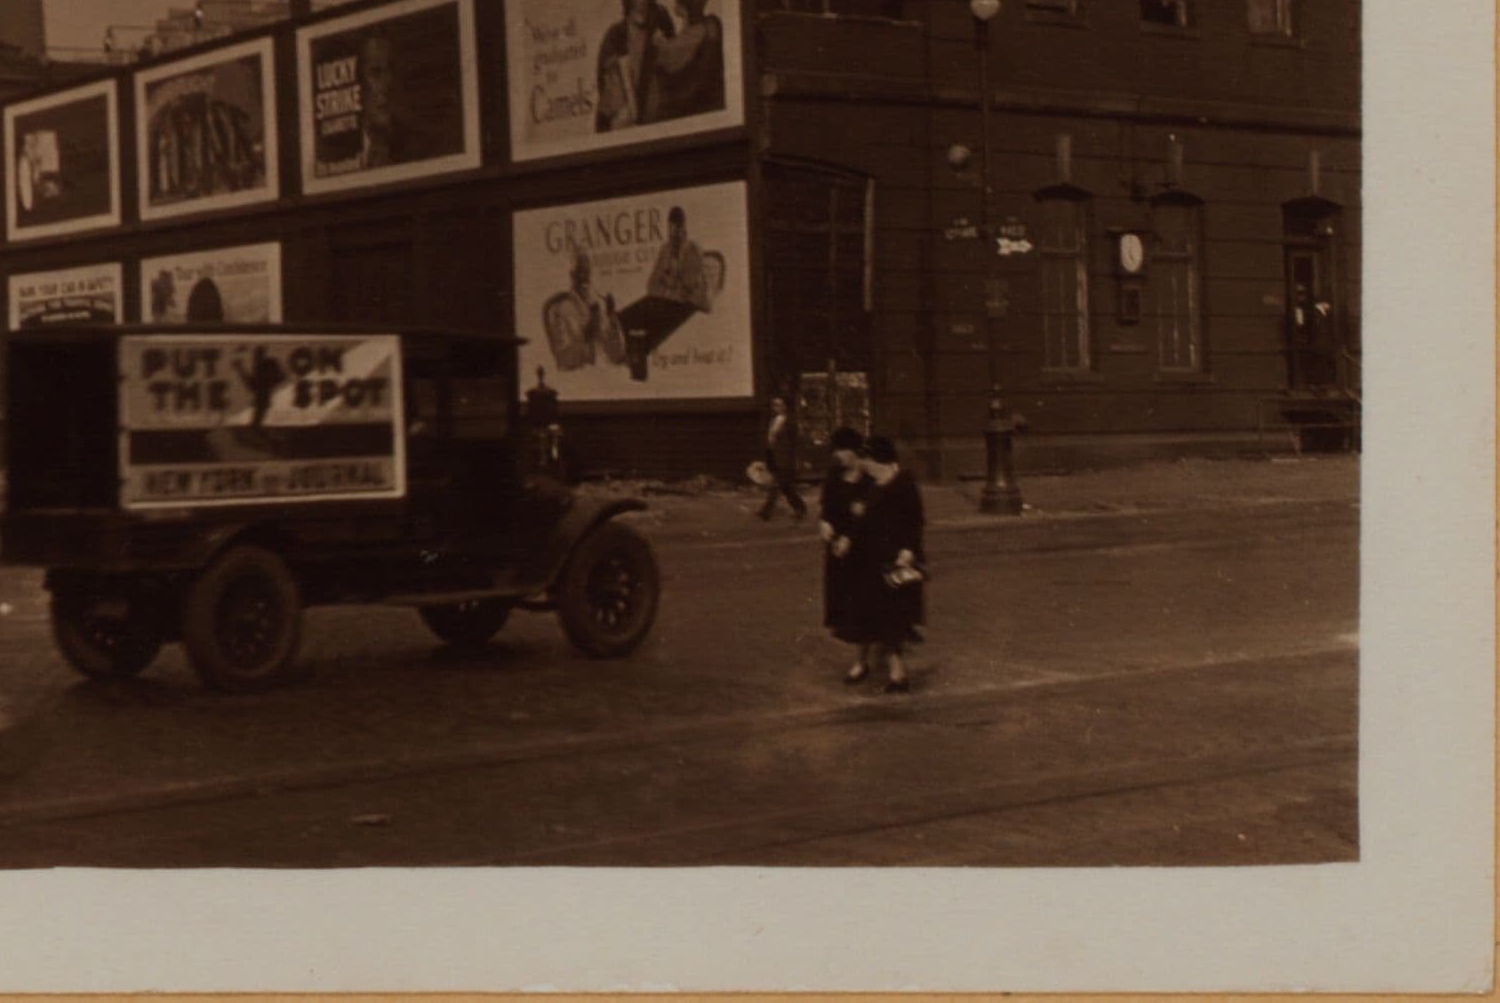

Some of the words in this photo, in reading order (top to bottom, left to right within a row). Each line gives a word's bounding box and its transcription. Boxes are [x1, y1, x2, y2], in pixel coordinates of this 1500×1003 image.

[317, 56, 356, 90] LUCKY
[316, 84, 362, 120] STRIKE
[545, 207, 662, 254] GRANGER
[141, 347, 220, 379] PUT
[288, 346, 344, 376] ON
[147, 378, 231, 412] THE
[293, 376, 387, 410] SPOT
